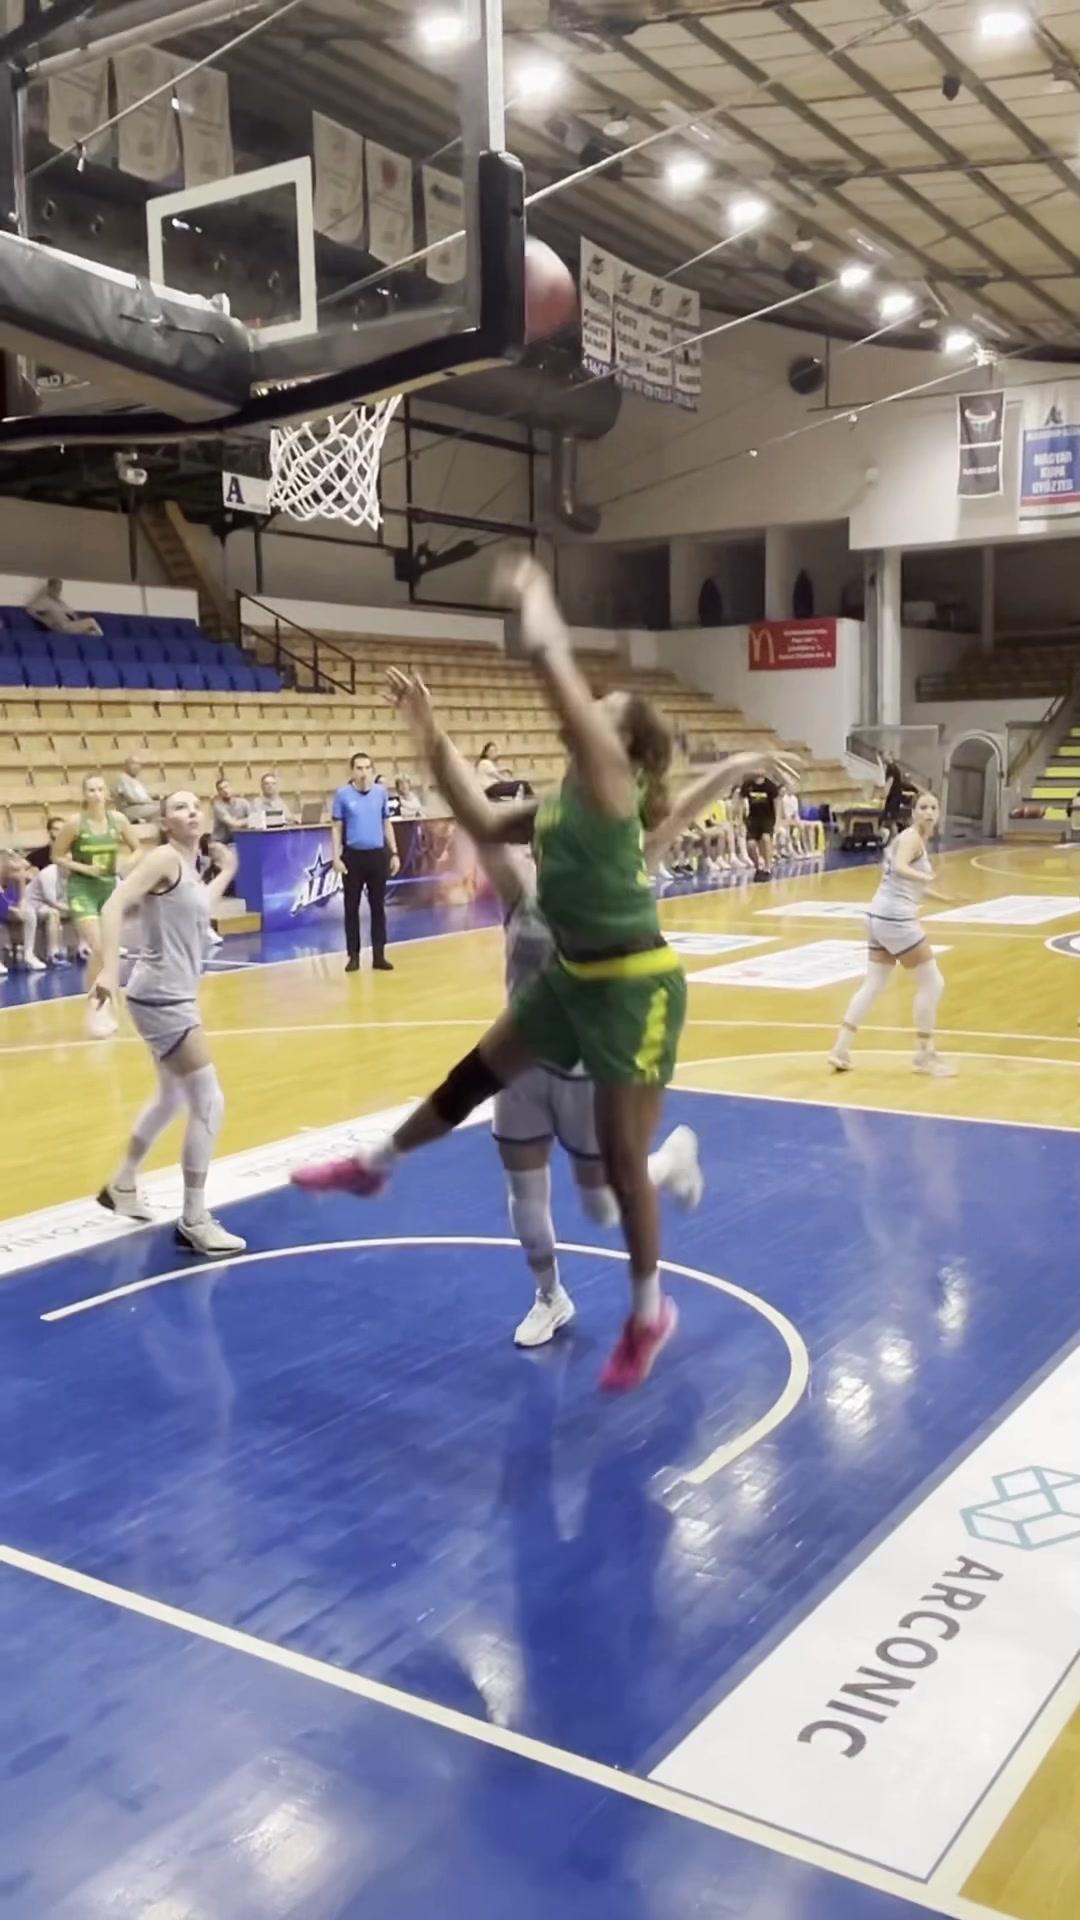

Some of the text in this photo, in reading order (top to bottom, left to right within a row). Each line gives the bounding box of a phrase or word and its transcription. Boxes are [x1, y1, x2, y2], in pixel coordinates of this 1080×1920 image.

[1034, 451, 1072, 466] MAGYAR
[1041, 465, 1065, 478] KUPA
[226, 476, 246, 504] A
[796, 1553, 1005, 1760] ARCONIC
